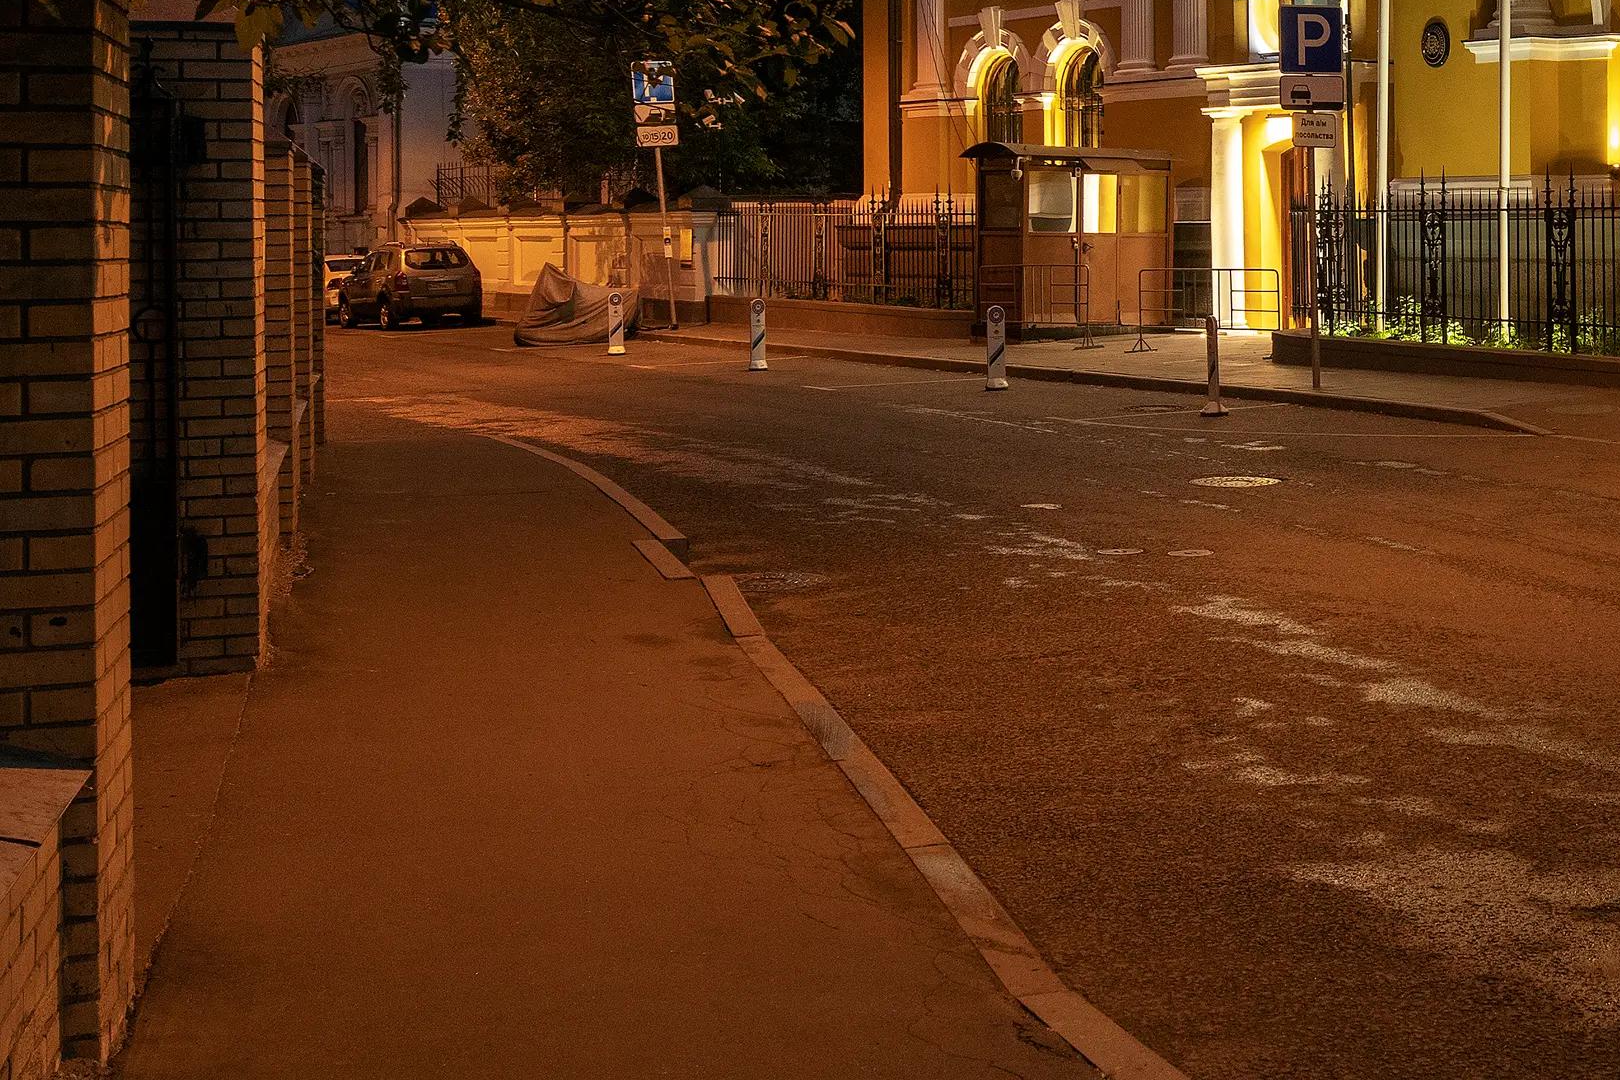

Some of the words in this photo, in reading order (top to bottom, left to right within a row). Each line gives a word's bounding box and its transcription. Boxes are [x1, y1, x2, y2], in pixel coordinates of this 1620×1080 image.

[1297, 13, 1331, 66] P
[1301, 118, 1315, 127] Для
[650, 132, 659, 140] 15
[661, 131, 673, 140] 20
[1295, 131, 1334, 140] посольства
